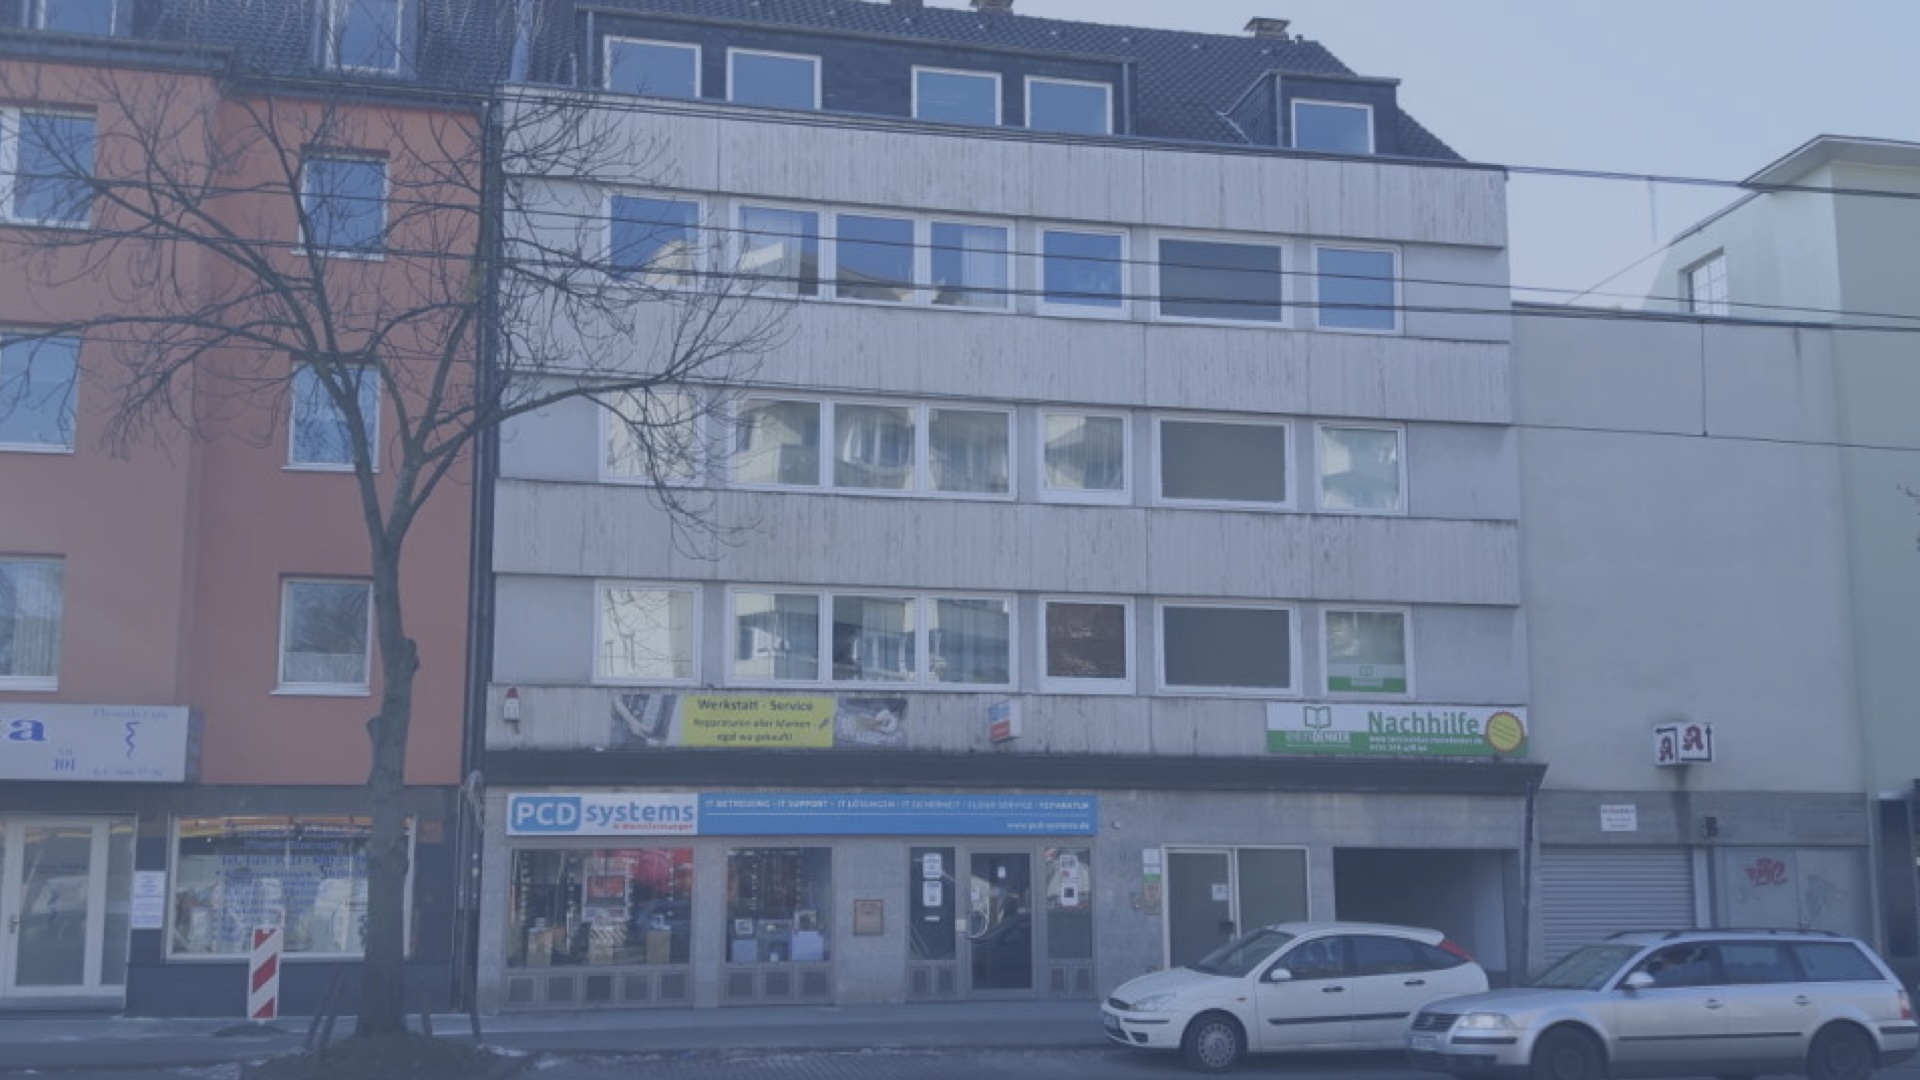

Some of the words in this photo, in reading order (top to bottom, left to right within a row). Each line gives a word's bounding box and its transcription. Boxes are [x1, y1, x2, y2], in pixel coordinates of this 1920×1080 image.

[697, 699, 759, 711] Werkstatt
[769, 699, 814, 712] Service
[1367, 710, 1480, 736] Nachhilfe
[517, 802, 577, 826] PCD
[585, 801, 695, 826] systems
